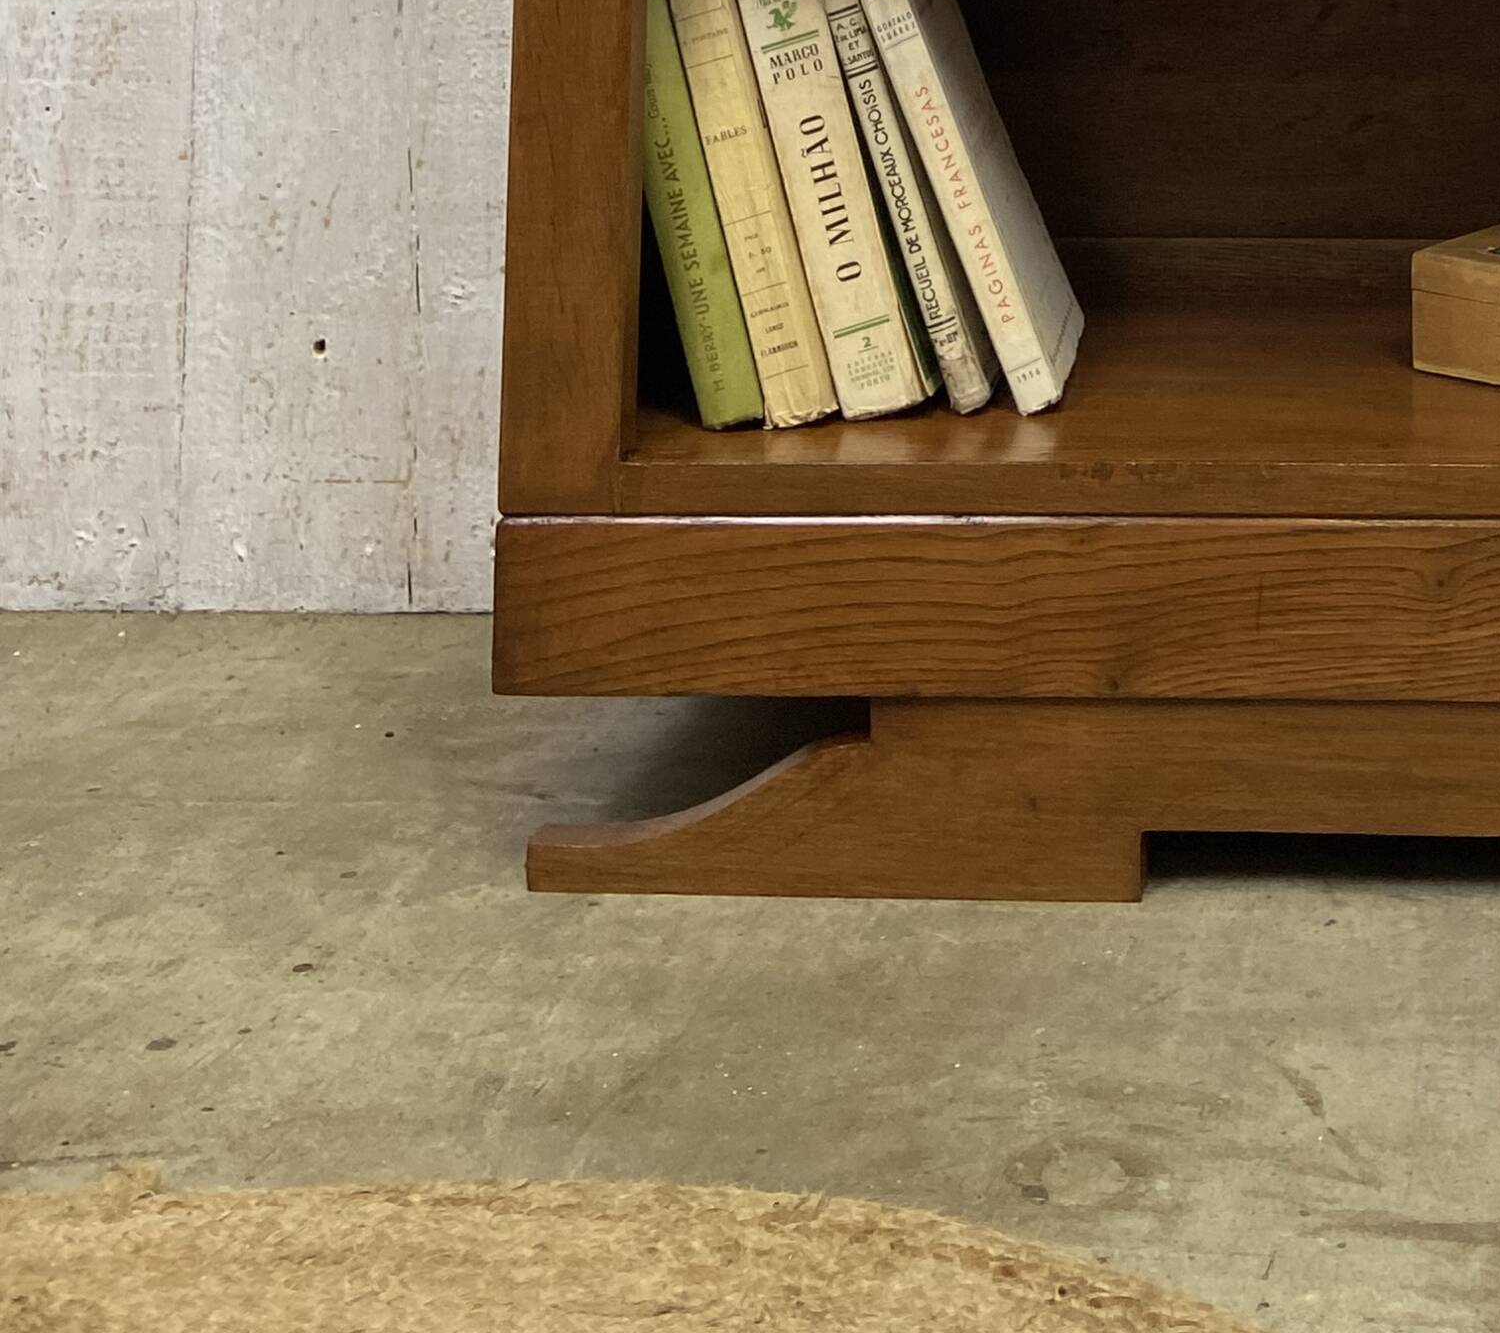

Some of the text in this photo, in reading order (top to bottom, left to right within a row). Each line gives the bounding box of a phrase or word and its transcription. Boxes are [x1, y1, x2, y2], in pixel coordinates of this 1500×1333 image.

[768, 43, 819, 69] MARCO
[848, 40, 859, 51] ET
[772, 58, 824, 86] POLO
[704, 125, 748, 146] FABLES
[914, 86, 972, 210] FRANCESAS
[799, 114, 862, 282] O MILHÃO
[859, 79, 943, 321] RECUEIL DE MORCEAUX CHOISIS
[667, 188, 700, 271] SEMAINE
[861, 336, 872, 348] 2
